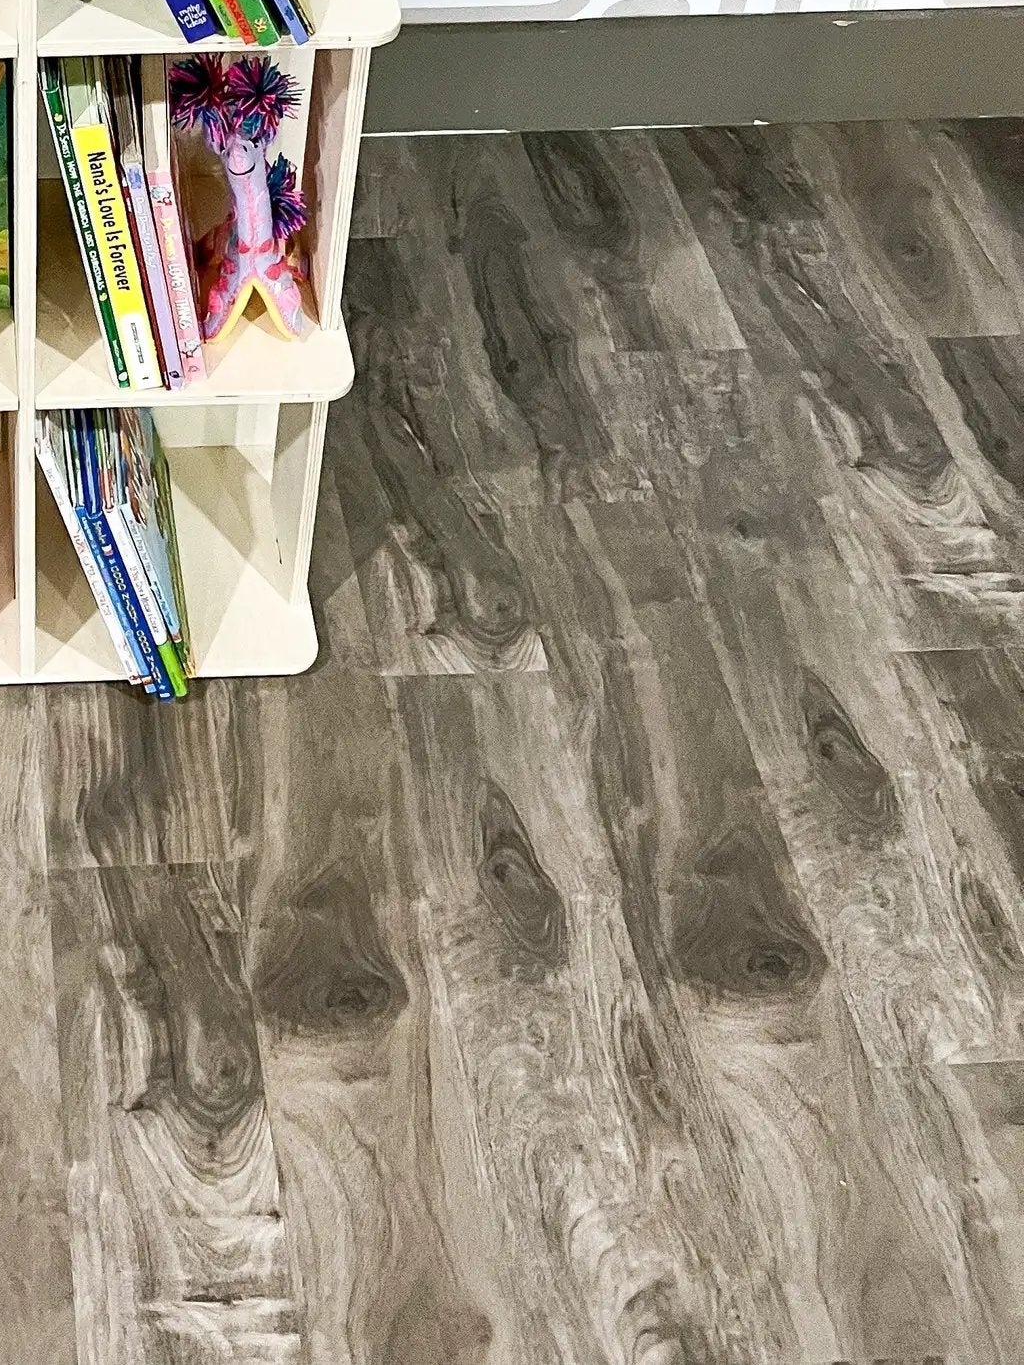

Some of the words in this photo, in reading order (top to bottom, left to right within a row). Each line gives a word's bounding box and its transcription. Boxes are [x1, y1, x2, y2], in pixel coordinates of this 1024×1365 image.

[66, 160, 79, 179] HOW
[86, 150, 114, 196] Nana's
[71, 181, 83, 198] THE
[75, 199, 91, 228] GRINCH
[97, 196, 120, 228] Love
[83, 230, 96, 248] LOST
[105, 229, 124, 242] Is
[87, 249, 106, 291] CHRISTMAS
[107, 242, 135, 292] Forever
[167, 262, 185, 294] LOVEY
[173, 297, 192, 330] THINGS
